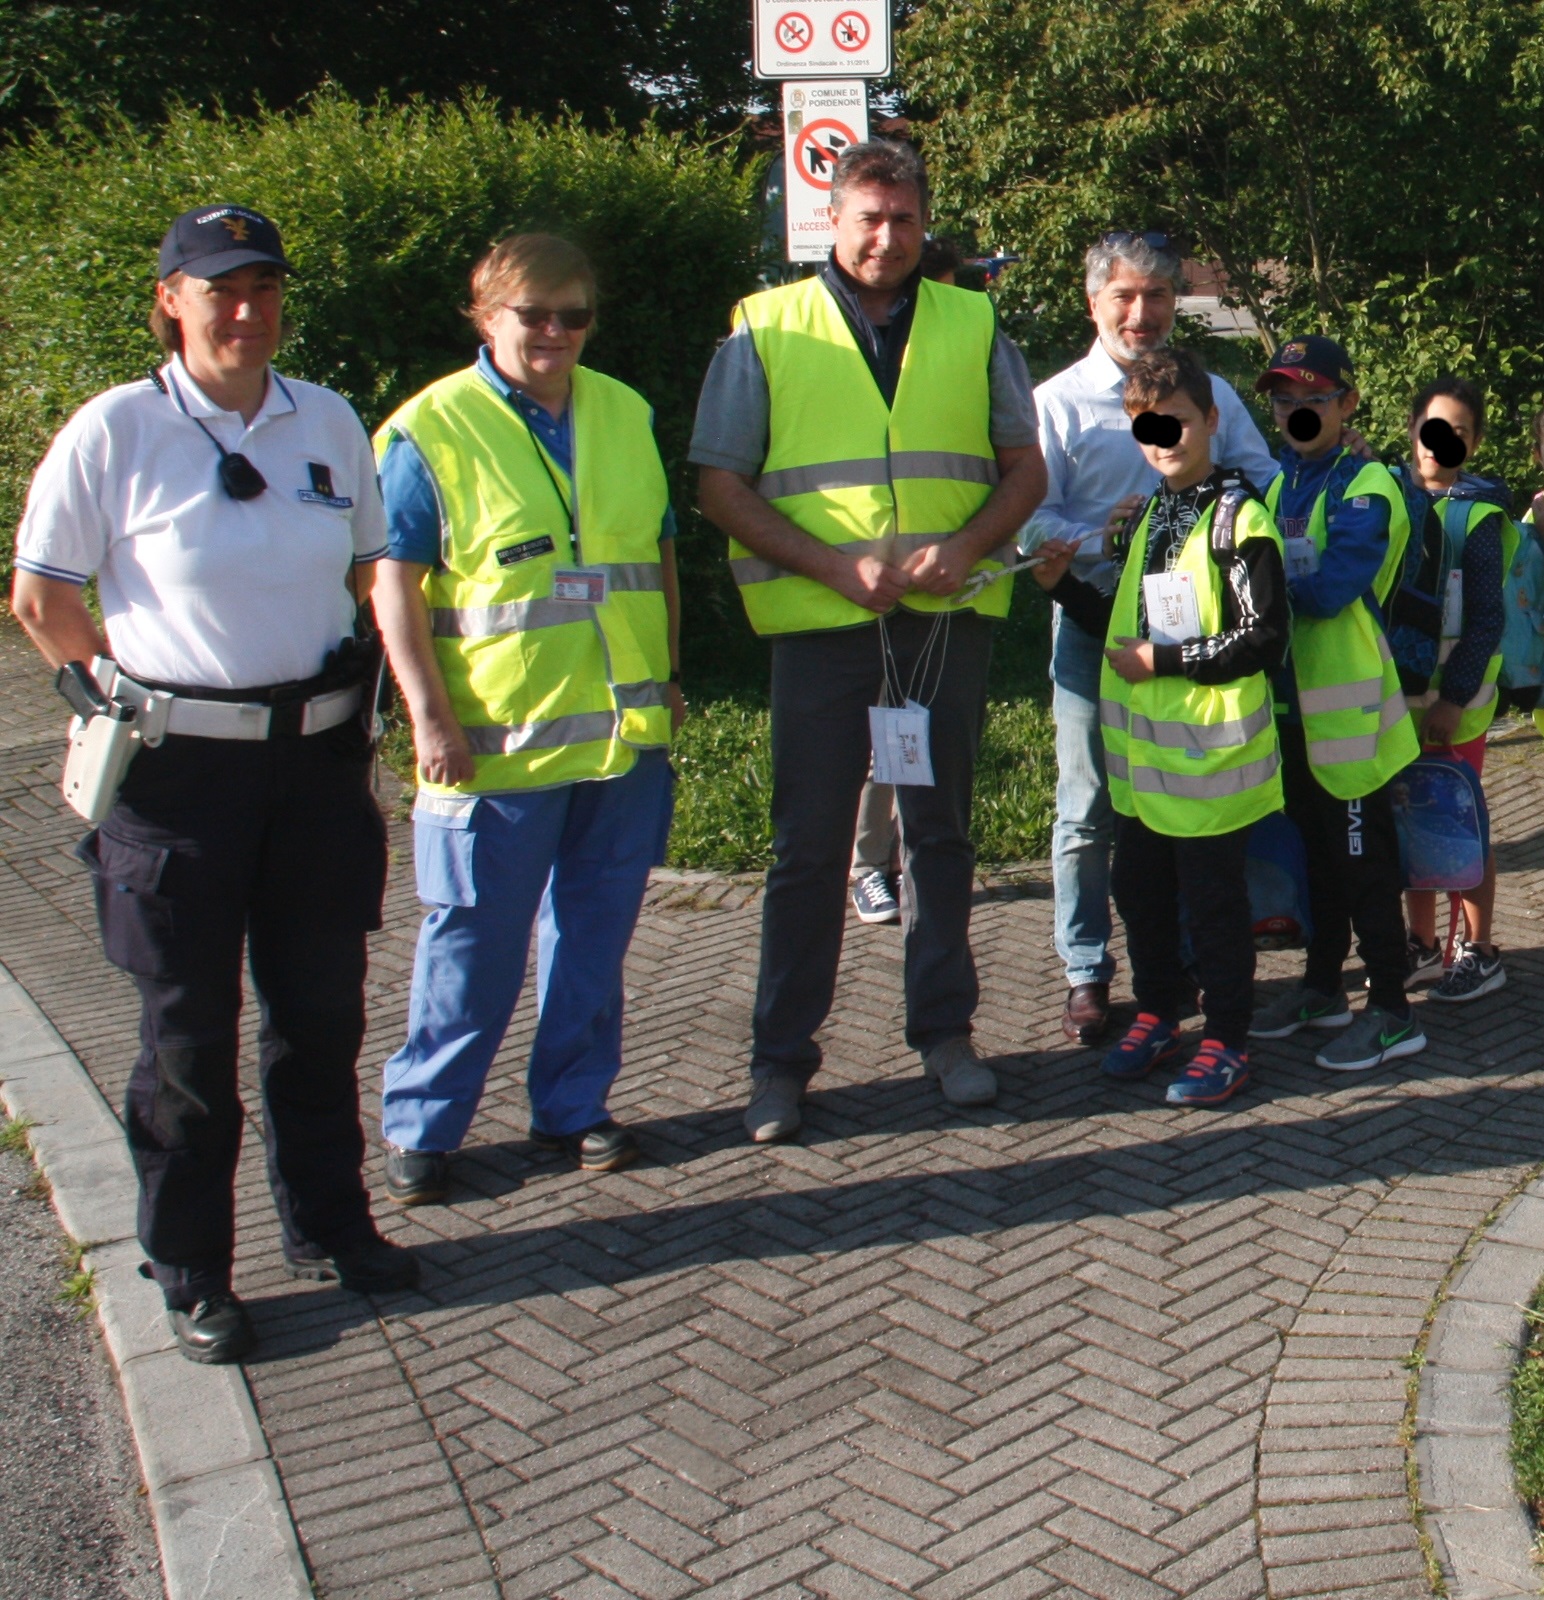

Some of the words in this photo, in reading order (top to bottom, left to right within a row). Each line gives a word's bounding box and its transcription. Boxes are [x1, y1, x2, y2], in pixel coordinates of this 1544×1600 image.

[811, 89, 848, 97] COMUNE
[850, 88, 858, 97] DI
[808, 98, 861, 107] PORDENONE
[813, 207, 827, 217] VIE
[791, 221, 831, 231] L'ACCESS
[1298, 369, 1315, 382] 10
